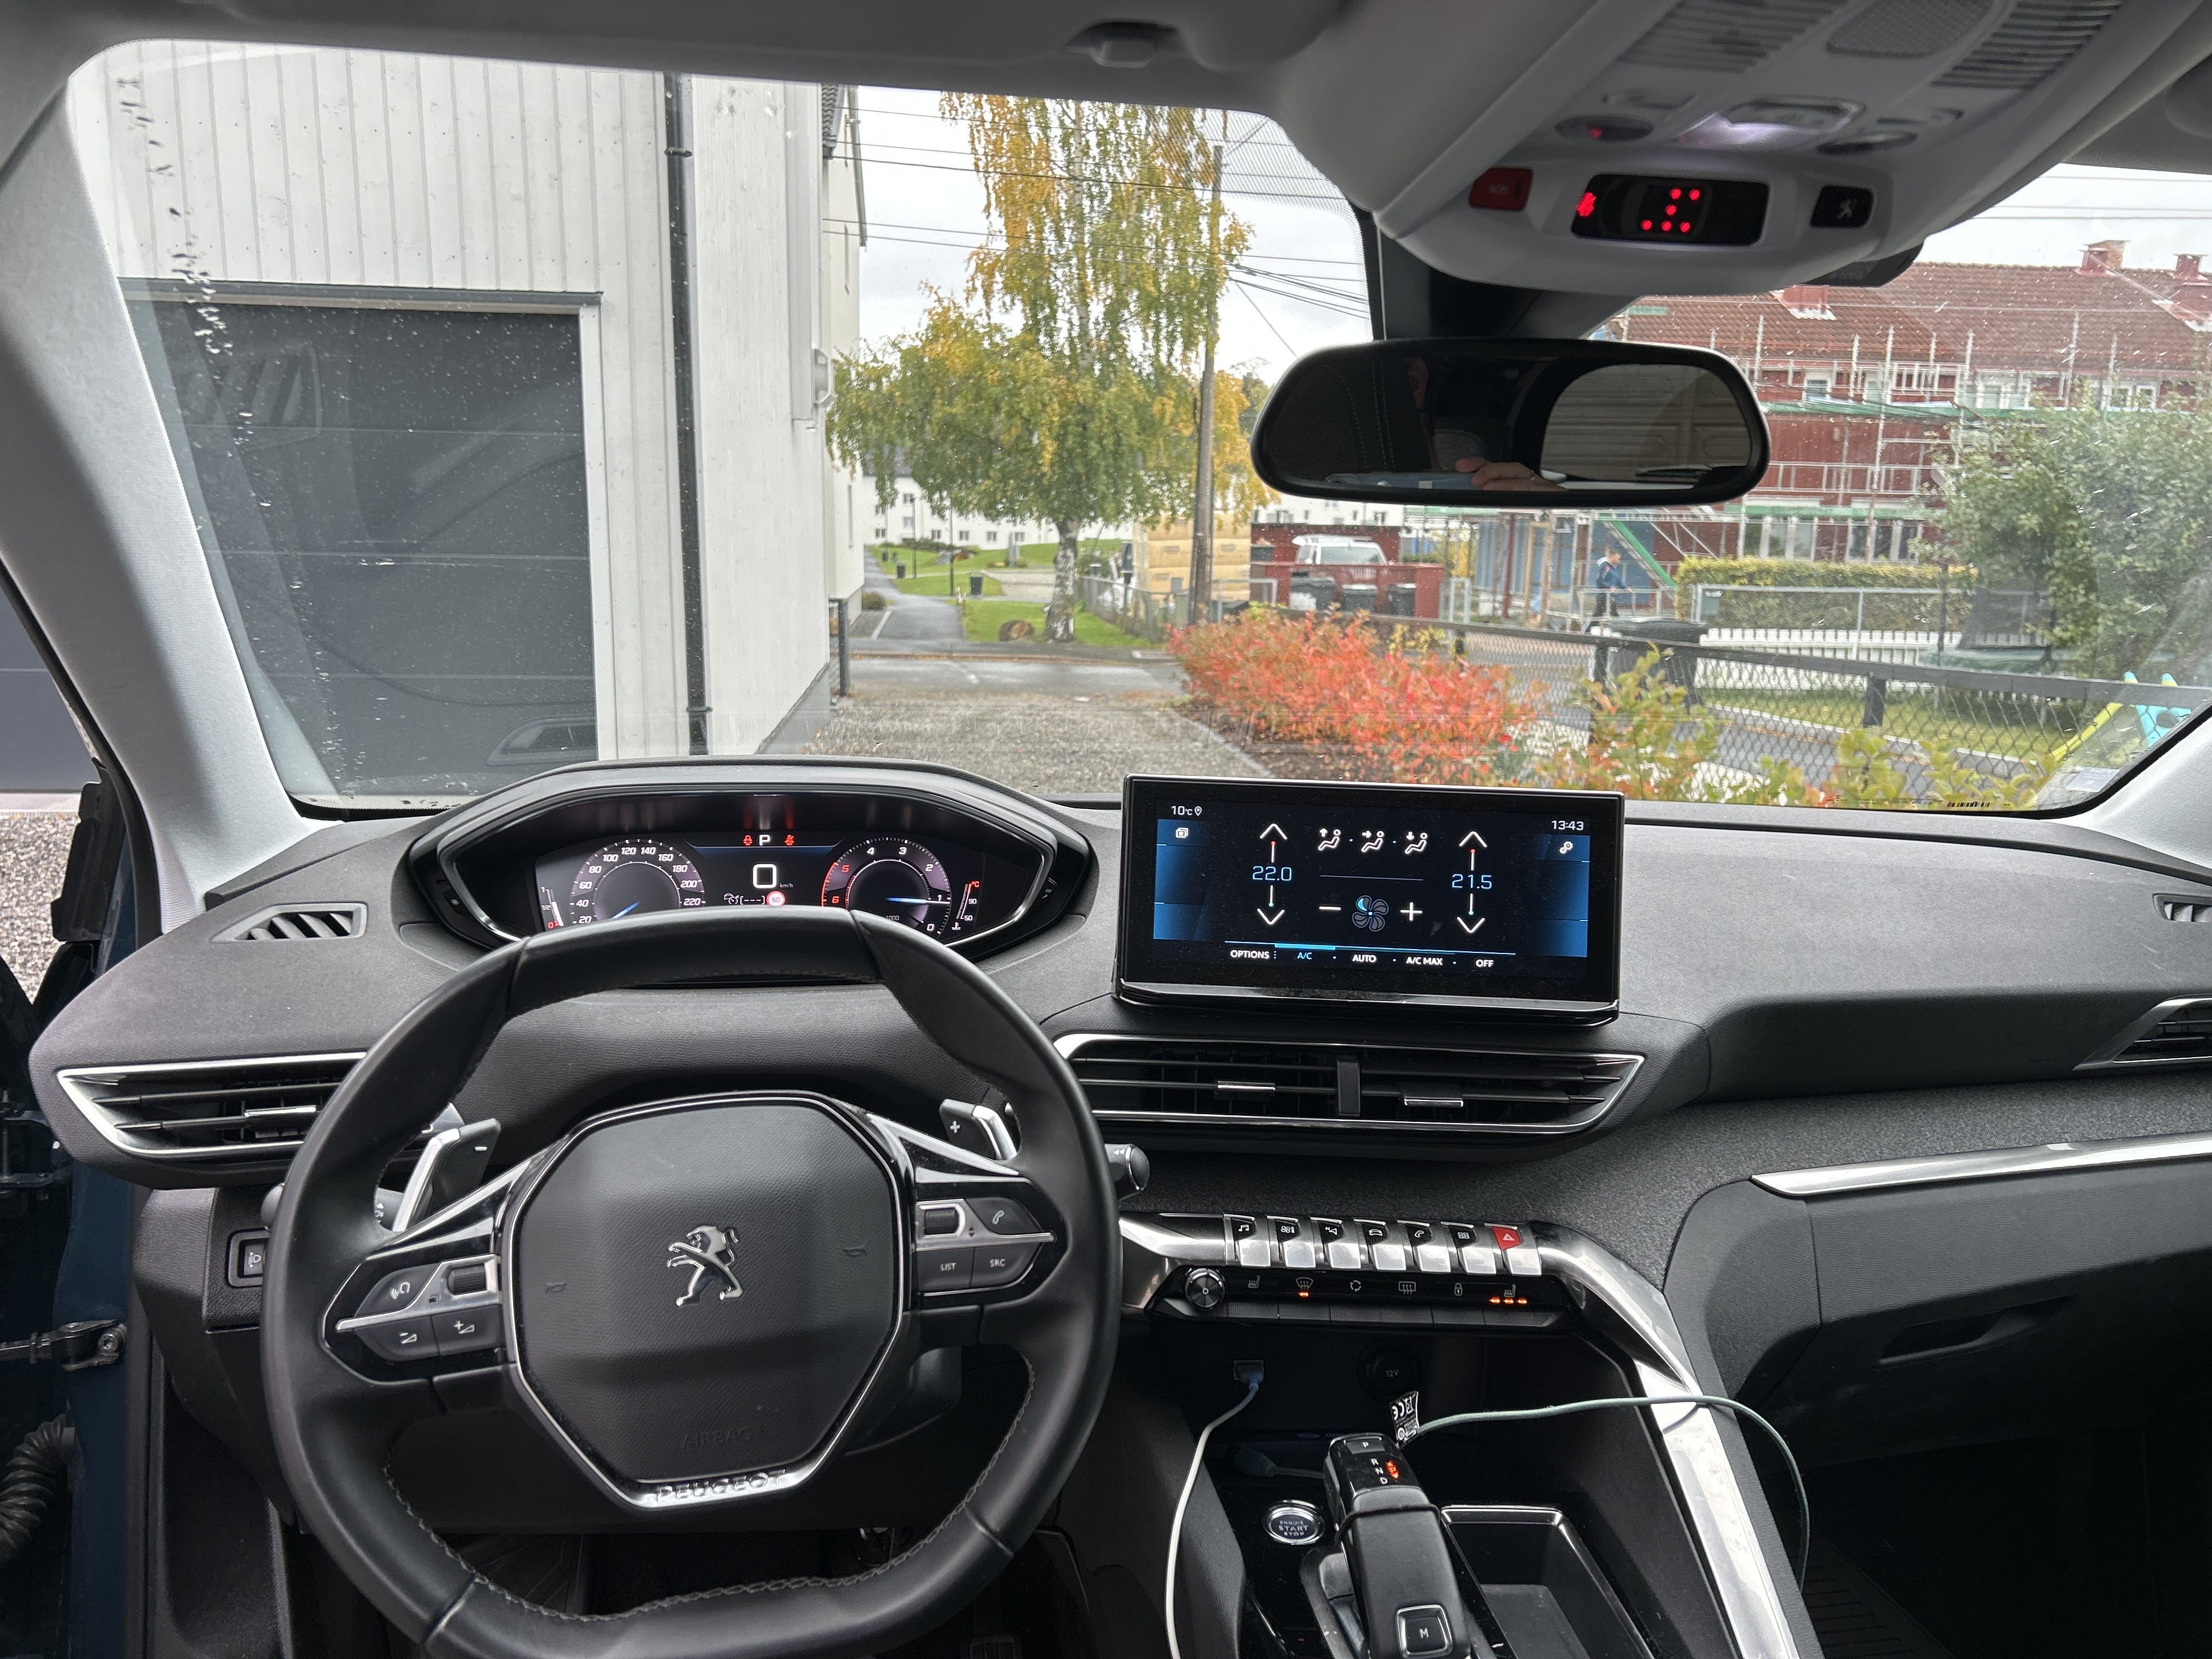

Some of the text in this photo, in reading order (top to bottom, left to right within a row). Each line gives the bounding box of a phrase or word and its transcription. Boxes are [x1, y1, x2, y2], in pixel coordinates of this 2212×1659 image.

[1551, 820, 1584, 831] 13:43
[759, 834, 770, 846] P
[899, 847, 907, 855] 3
[925, 864, 933, 872] 2
[753, 864, 777, 888] 0
[1252, 865, 1293, 882] 22.0
[1452, 873, 1492, 890] 21.5
[831, 895, 839, 904] 6
[578, 916, 592, 924] 20
[1230, 950, 1269, 959] OPTIONS
[1297, 951, 1312, 960] A/C
[1352, 954, 1377, 963] AUTO
[1406, 956, 1443, 966] A/C MAX
[1475, 959, 1494, 967] OFF
[940, 1262, 956, 1271] LIST
[1385, 1369, 1400, 1378] 12V
[1380, 1476, 1388, 1485] D
[657, 1469, 786, 1503] PEUGEOT
[1419, 1627, 1429, 1639] M
